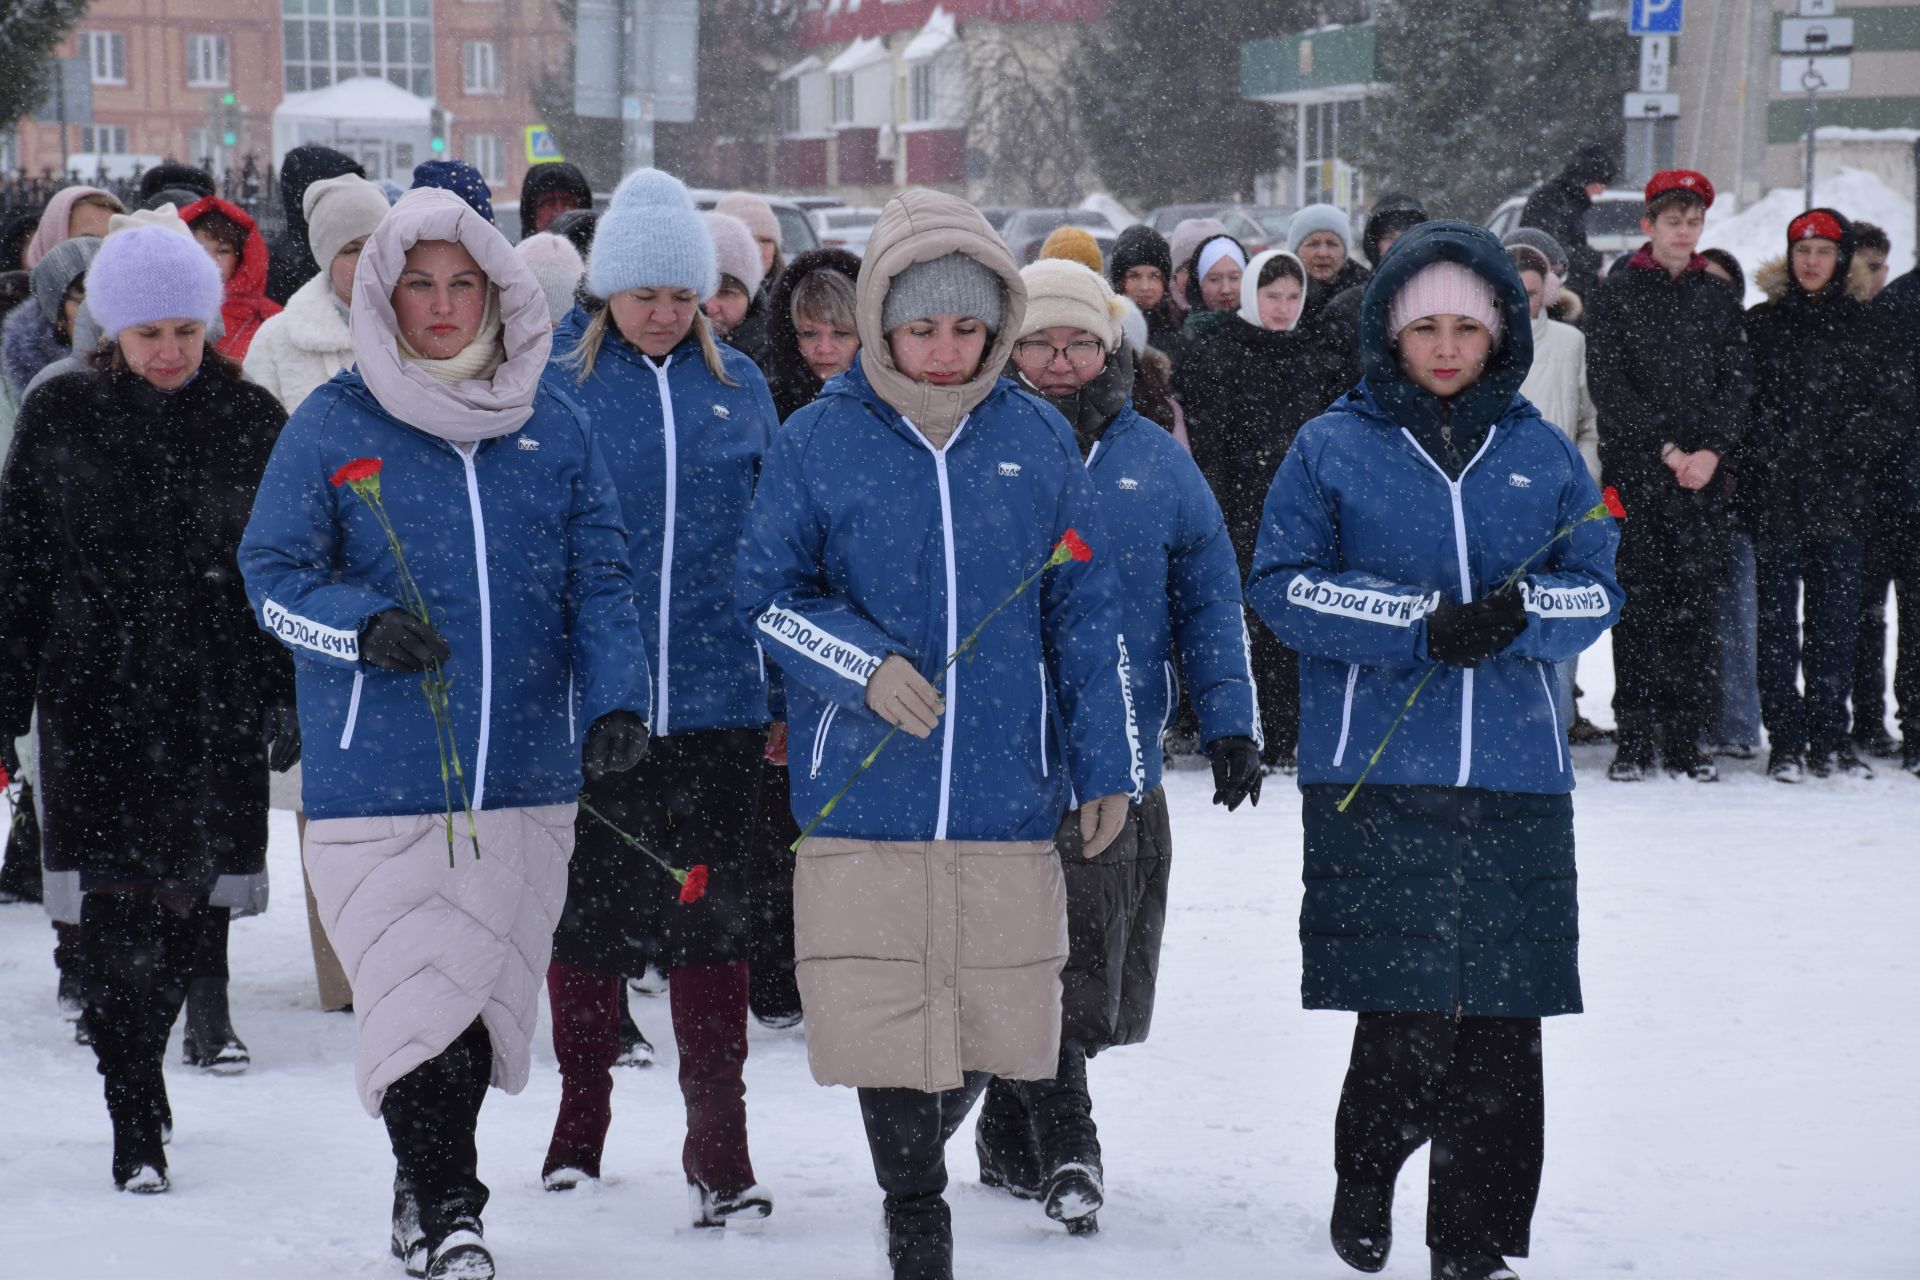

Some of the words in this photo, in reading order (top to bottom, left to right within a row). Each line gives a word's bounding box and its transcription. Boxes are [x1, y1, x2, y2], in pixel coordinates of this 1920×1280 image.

[1642, 0, 1671, 27] P
[1291, 582, 1369, 612] РОССИЯ
[1372, 596, 1420, 620] НАЯ
[322, 632, 357, 654] НАЯ
[760, 612, 823, 653] РОССИЯ
[820, 641, 880, 679] ДИНАЯ
